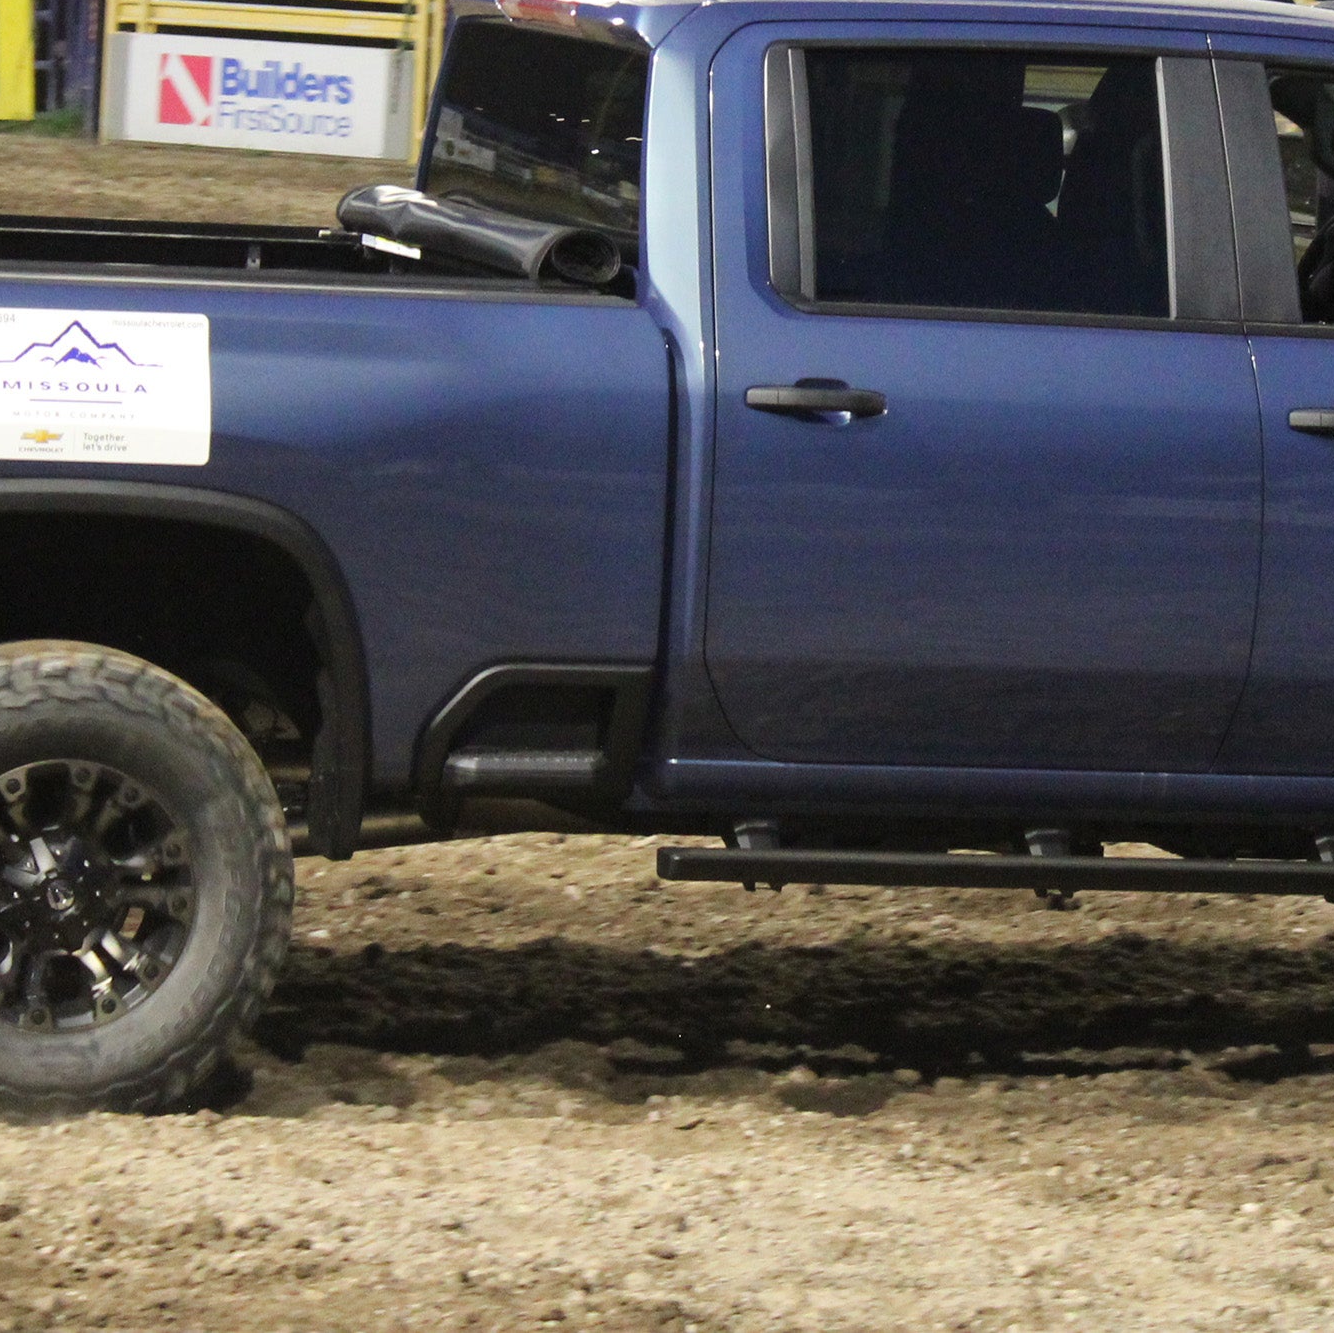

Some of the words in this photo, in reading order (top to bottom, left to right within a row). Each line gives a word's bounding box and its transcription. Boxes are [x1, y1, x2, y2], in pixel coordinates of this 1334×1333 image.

[220, 57, 354, 104] Builders
[218, 101, 353, 137] FirstSource
[111, 319, 205, 330] missoulachevrolet.com
[2, 380, 148, 394] MISSOULA
[12, 410, 61, 418] MOTOR
[69, 411, 136, 420] COMPANY
[83, 432, 125, 443] Together
[18, 446, 65, 454] CHEVROLET
[82, 443, 103, 452] let's
[104, 443, 128, 453] drive
